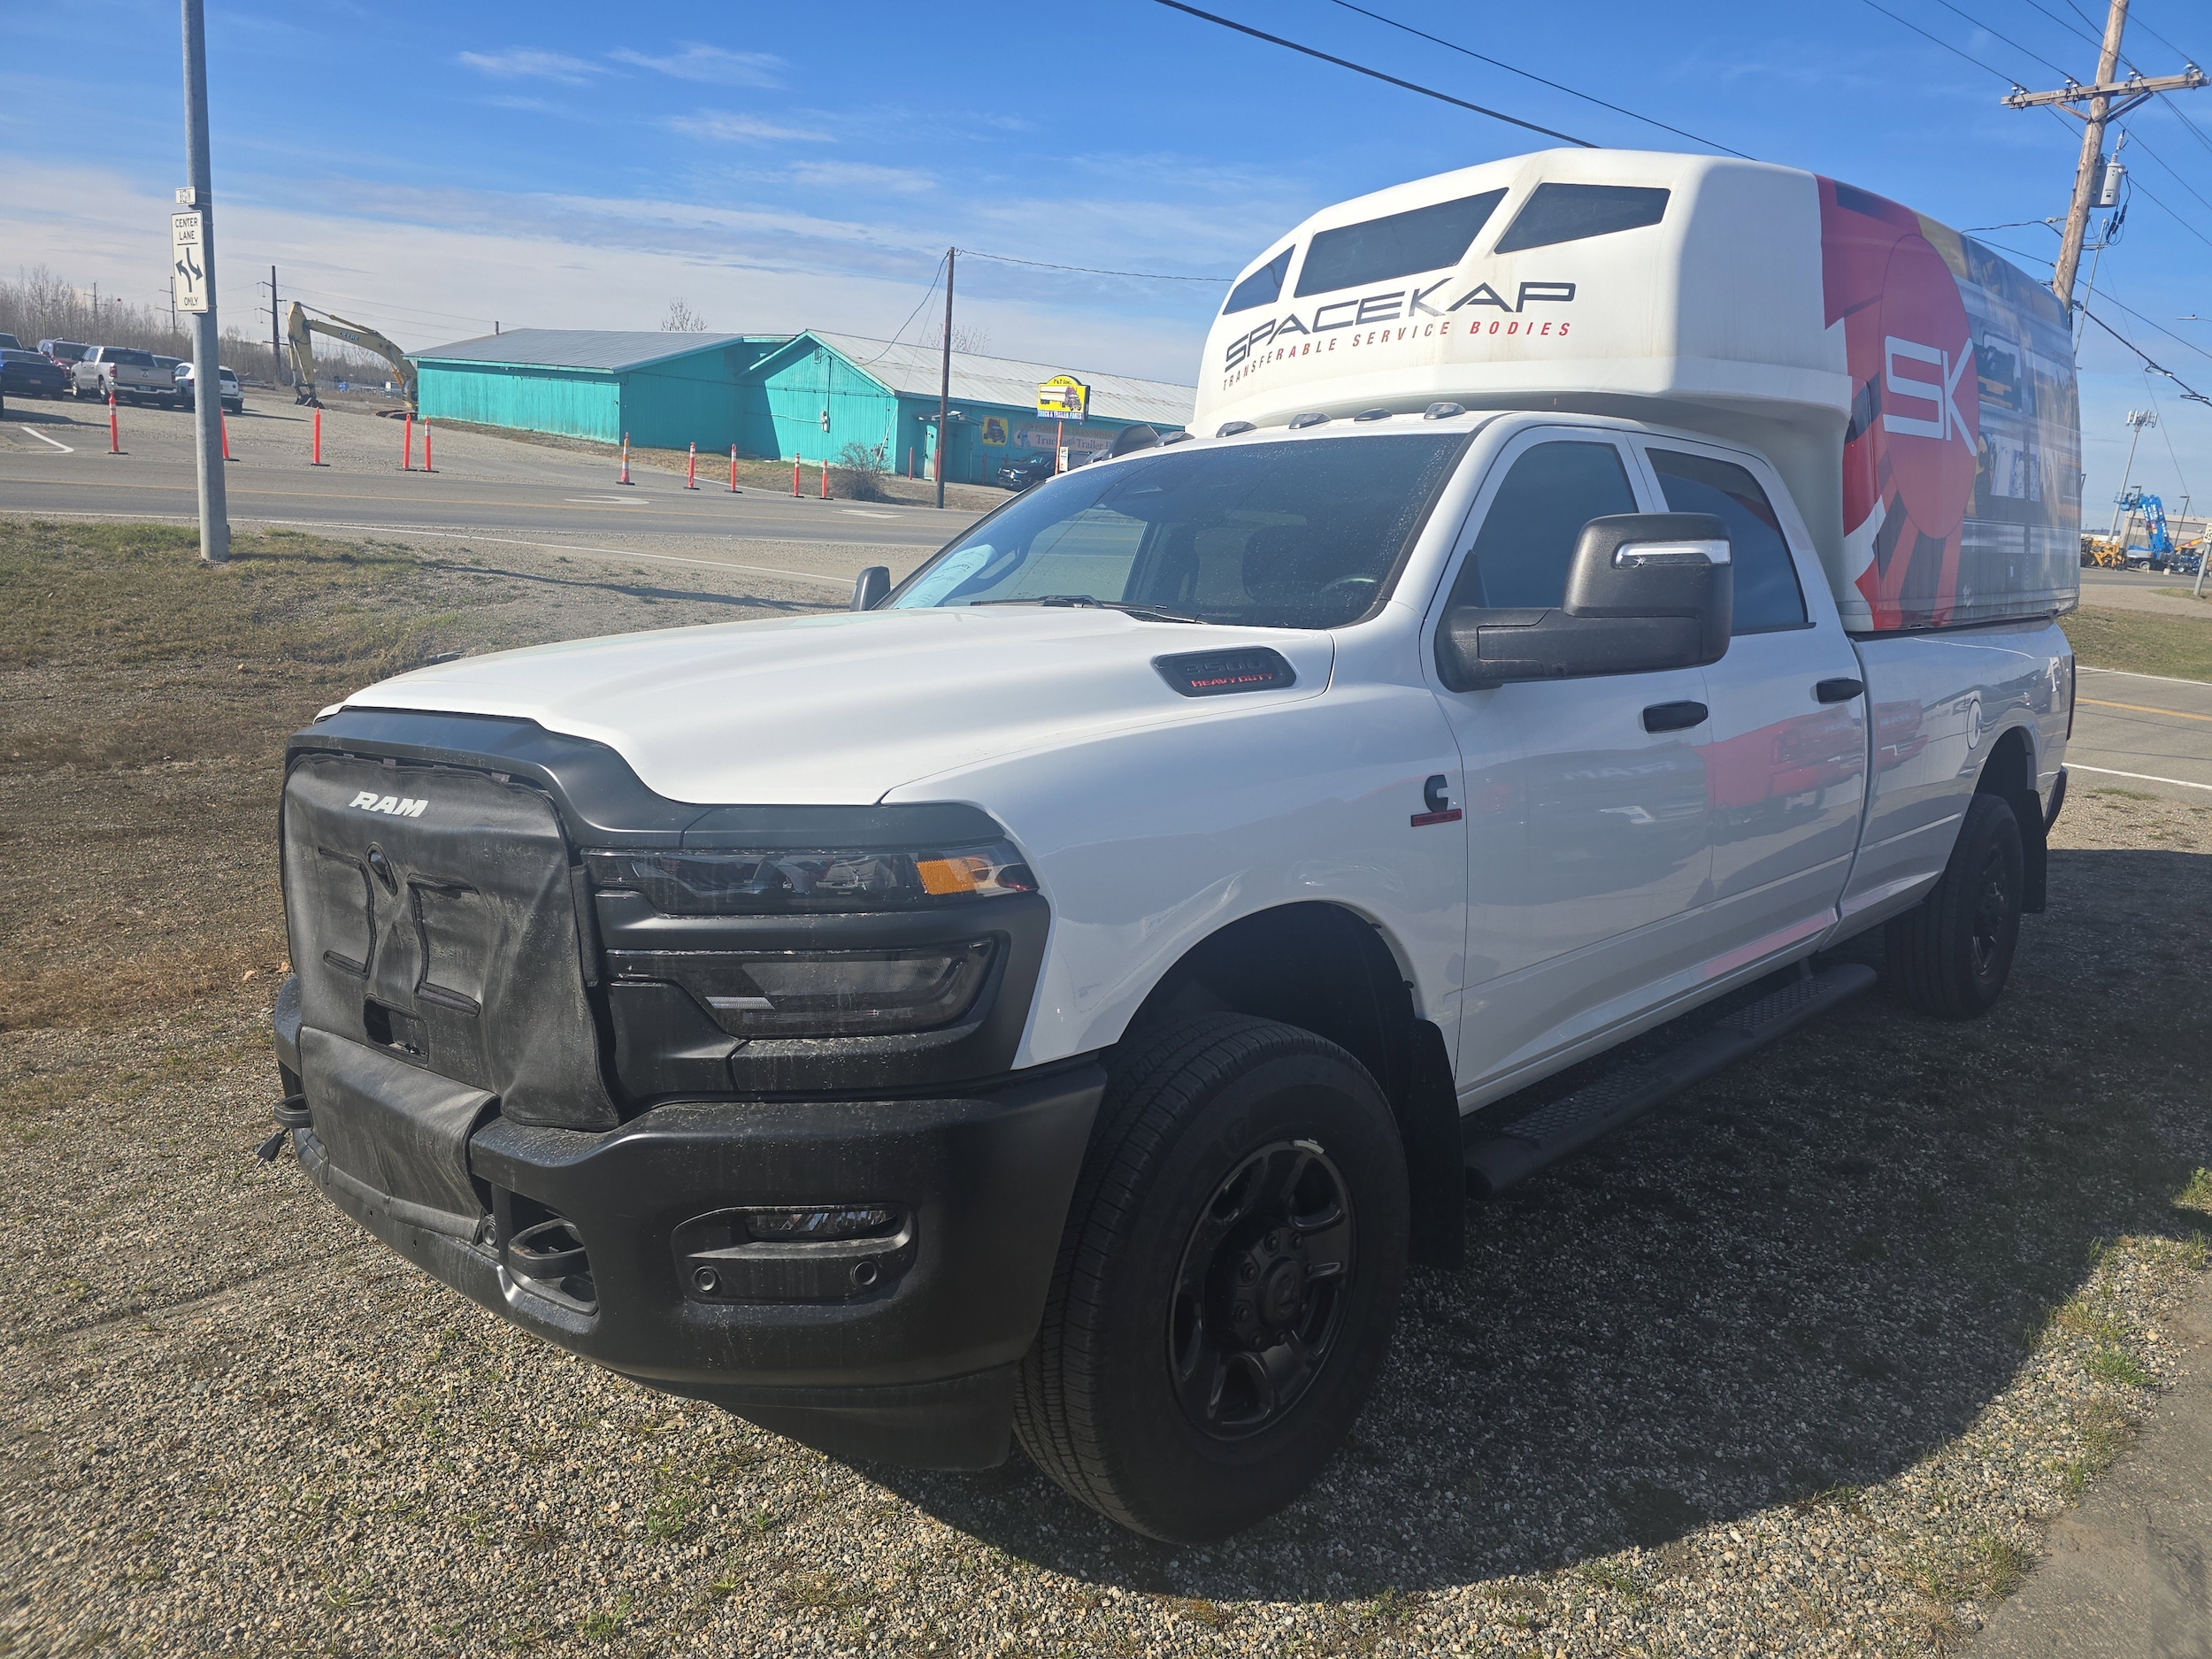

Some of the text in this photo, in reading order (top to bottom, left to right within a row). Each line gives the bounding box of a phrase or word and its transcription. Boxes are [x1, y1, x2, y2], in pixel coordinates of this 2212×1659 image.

[175, 217, 198, 228] CENTER
[179, 230, 196, 241] LANE
[183, 296, 199, 307] ONLY
[1225, 277, 1577, 373] SPACEKAP
[1223, 320, 1573, 392] TRANSFERABLE SERVICE BODIES
[1883, 334, 1977, 457] SK
[1036, 434, 1056, 445] Truc
[1076, 438, 1103, 450] Trailer
[1191, 673, 1273, 687] HEAVY DUTY
[349, 791, 429, 818] RAM
